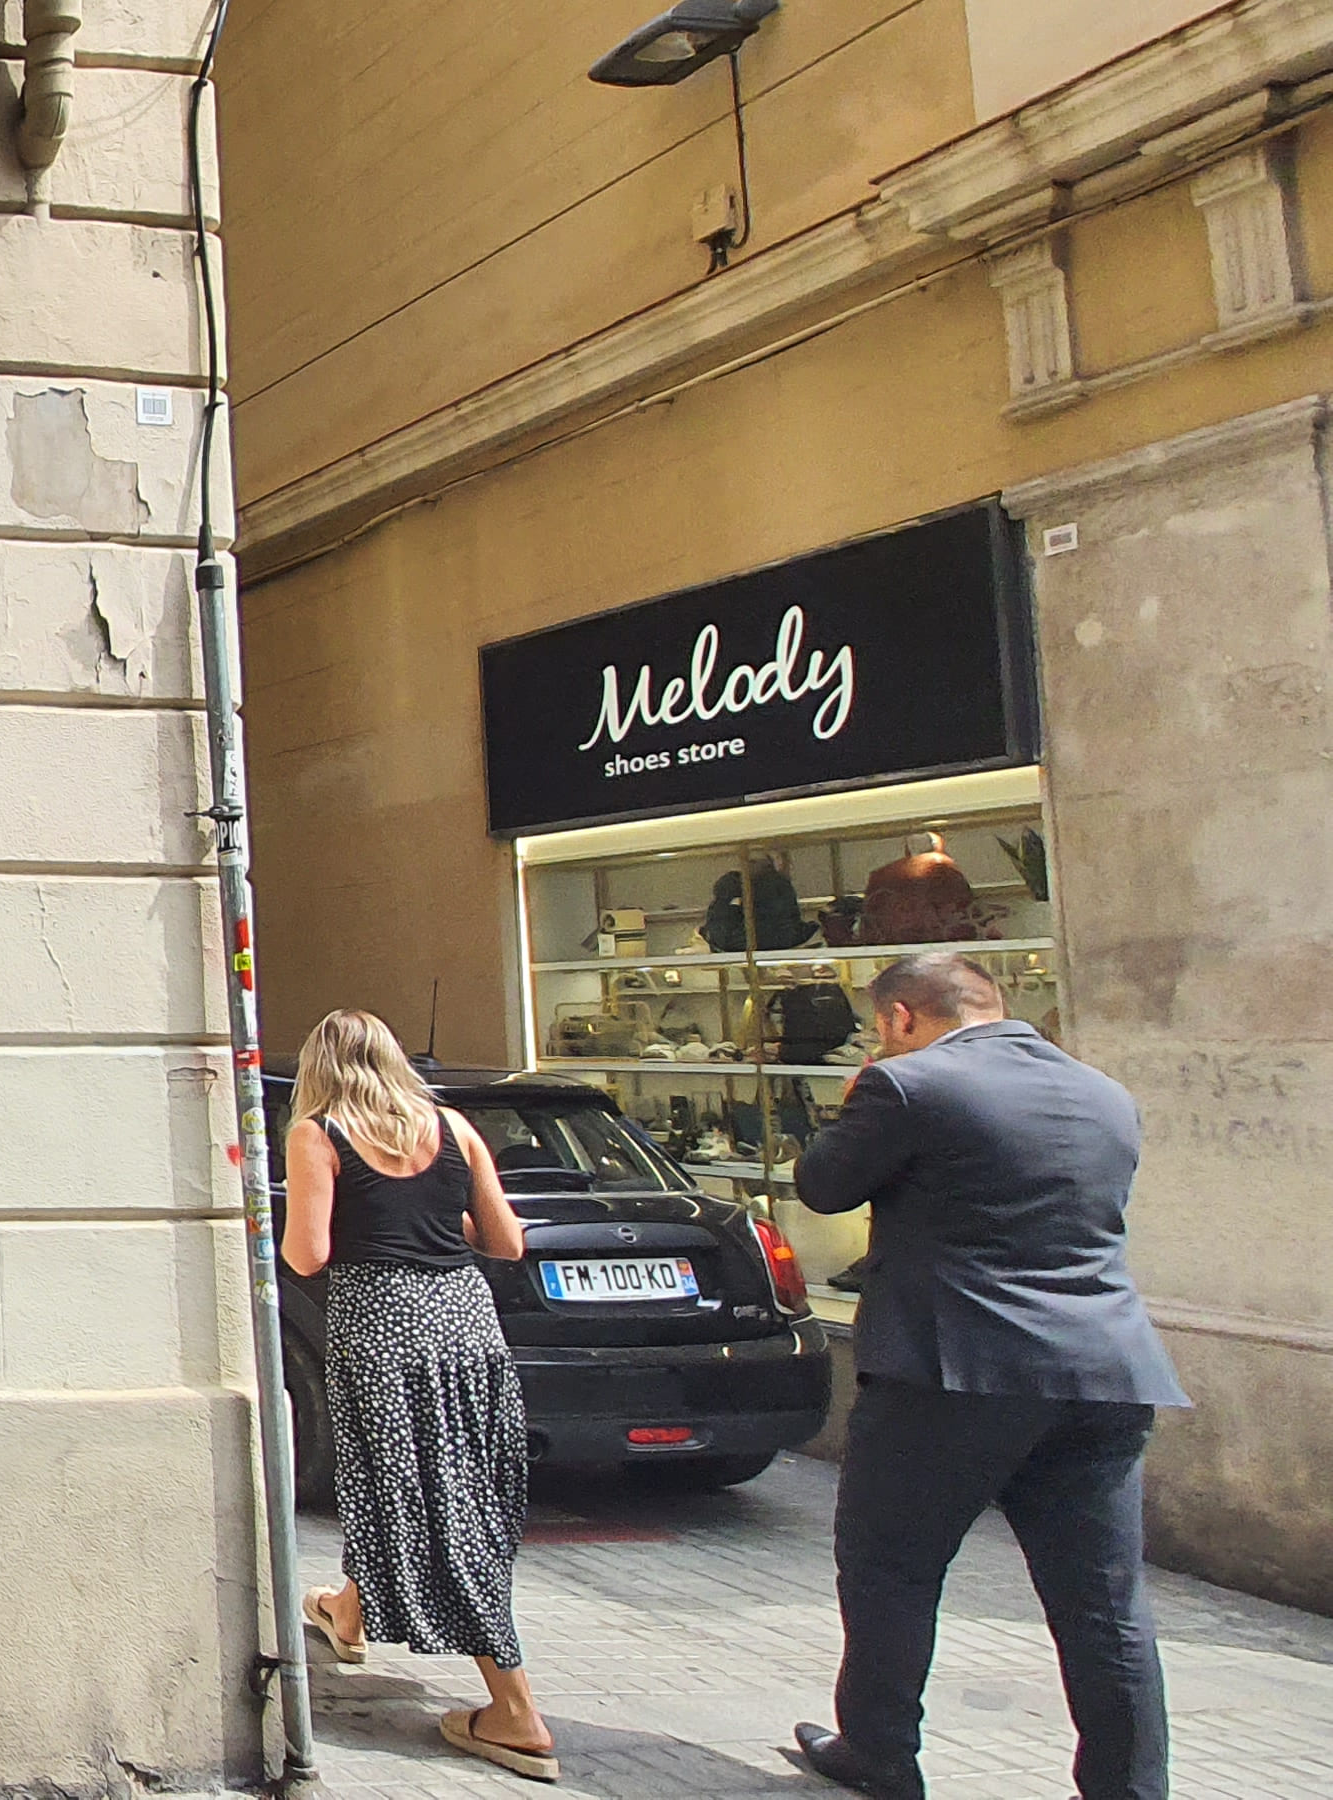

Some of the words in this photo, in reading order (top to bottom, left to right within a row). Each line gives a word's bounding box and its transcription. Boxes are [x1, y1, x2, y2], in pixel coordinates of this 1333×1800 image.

[578, 604, 854, 752] Melody
[604, 749, 670, 778] shoes
[679, 736, 746, 765] store
